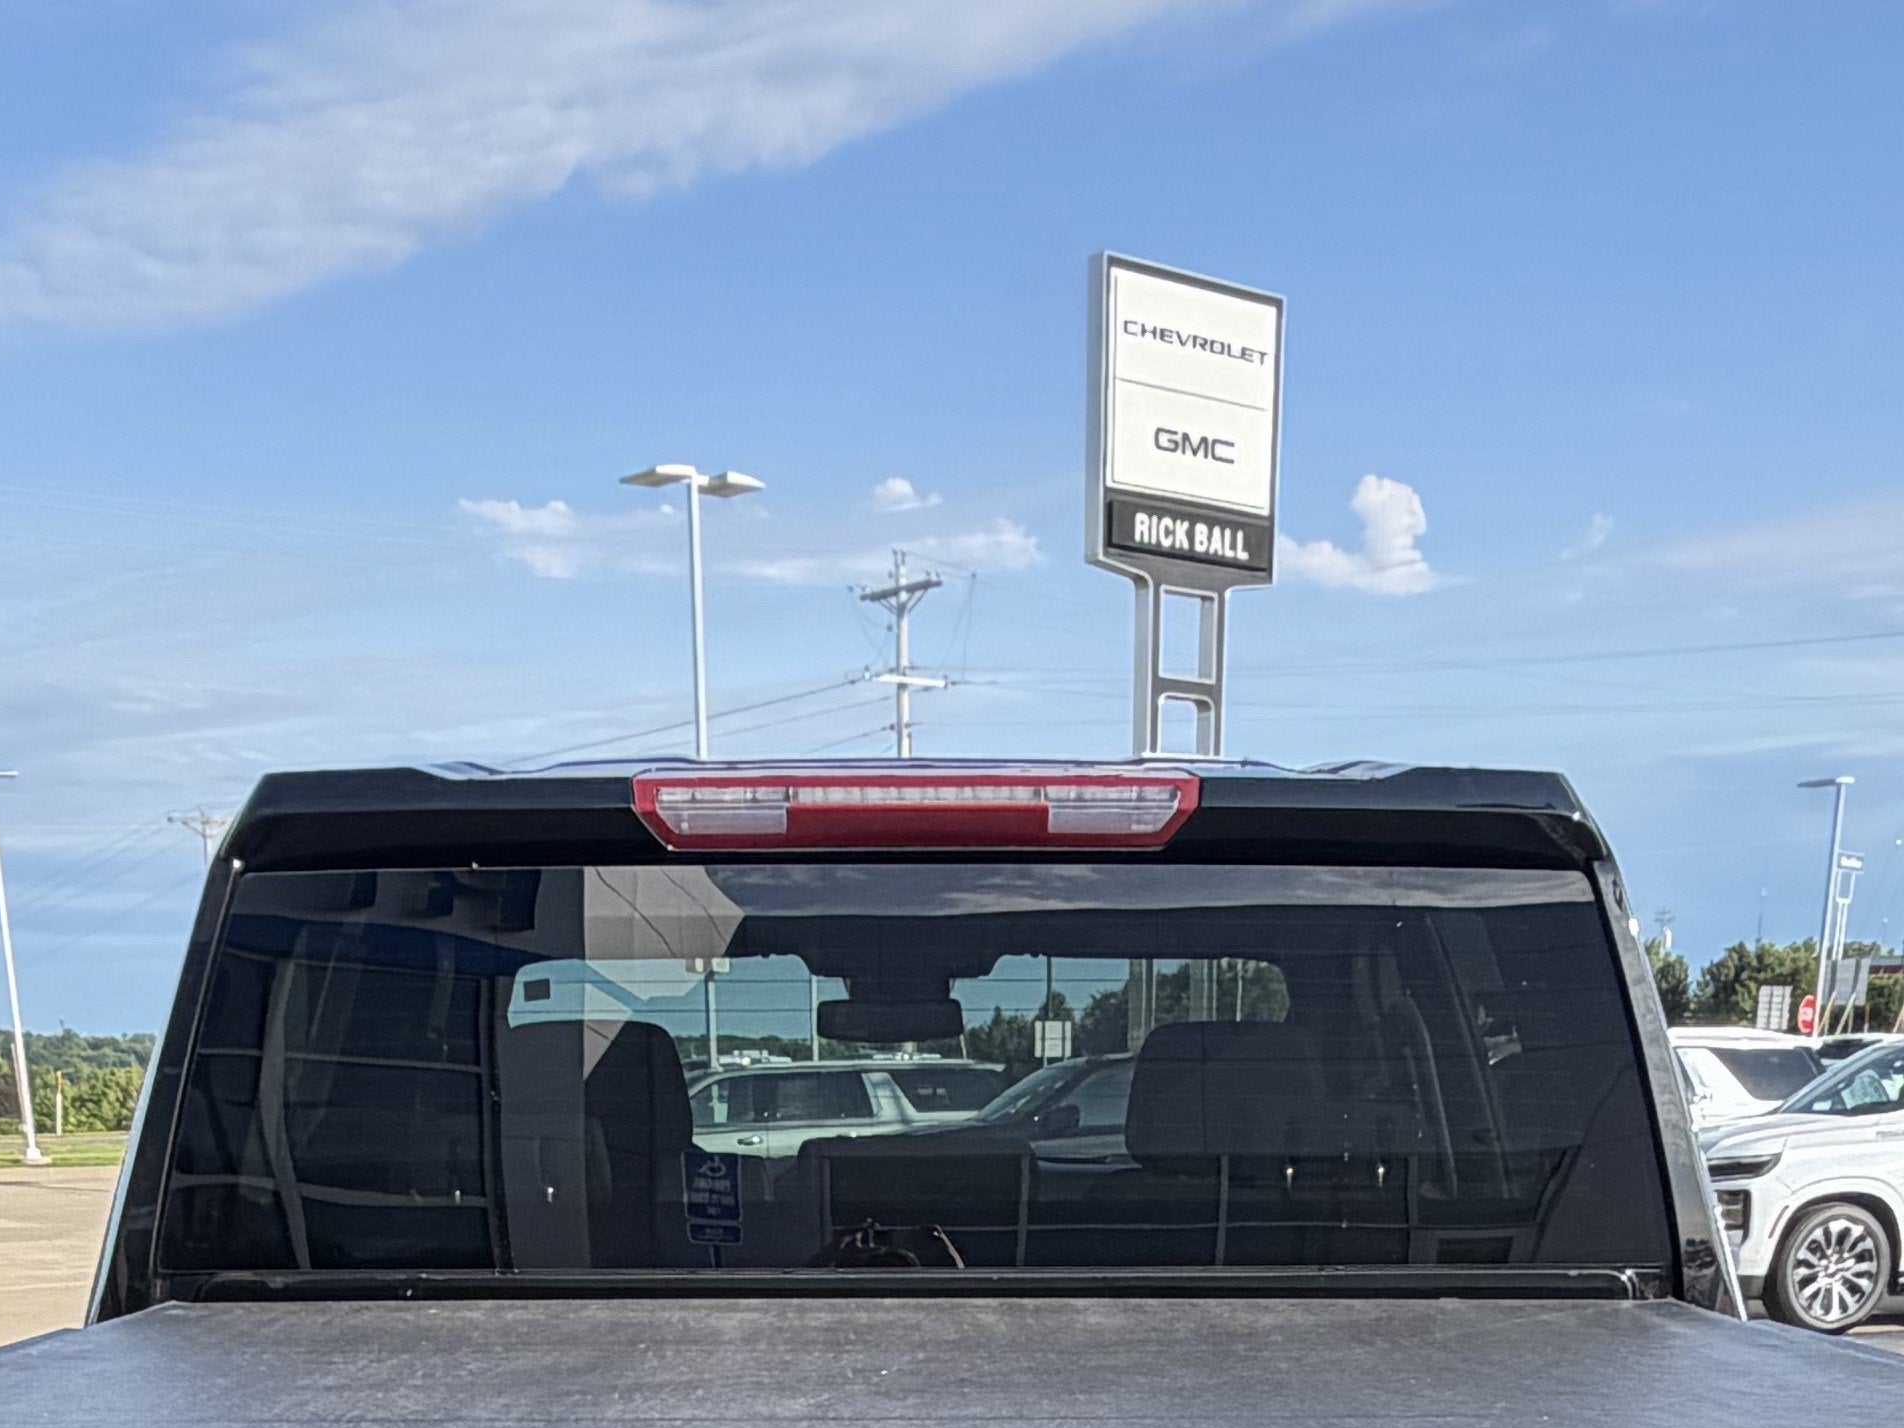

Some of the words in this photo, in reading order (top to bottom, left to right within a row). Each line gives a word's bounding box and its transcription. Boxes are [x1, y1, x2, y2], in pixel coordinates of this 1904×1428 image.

[1122, 318, 1269, 367] CHEVROLET
[1153, 426, 1236, 465] GMC
[1134, 511, 1190, 551] RICK
[1194, 522, 1250, 561] BALL
